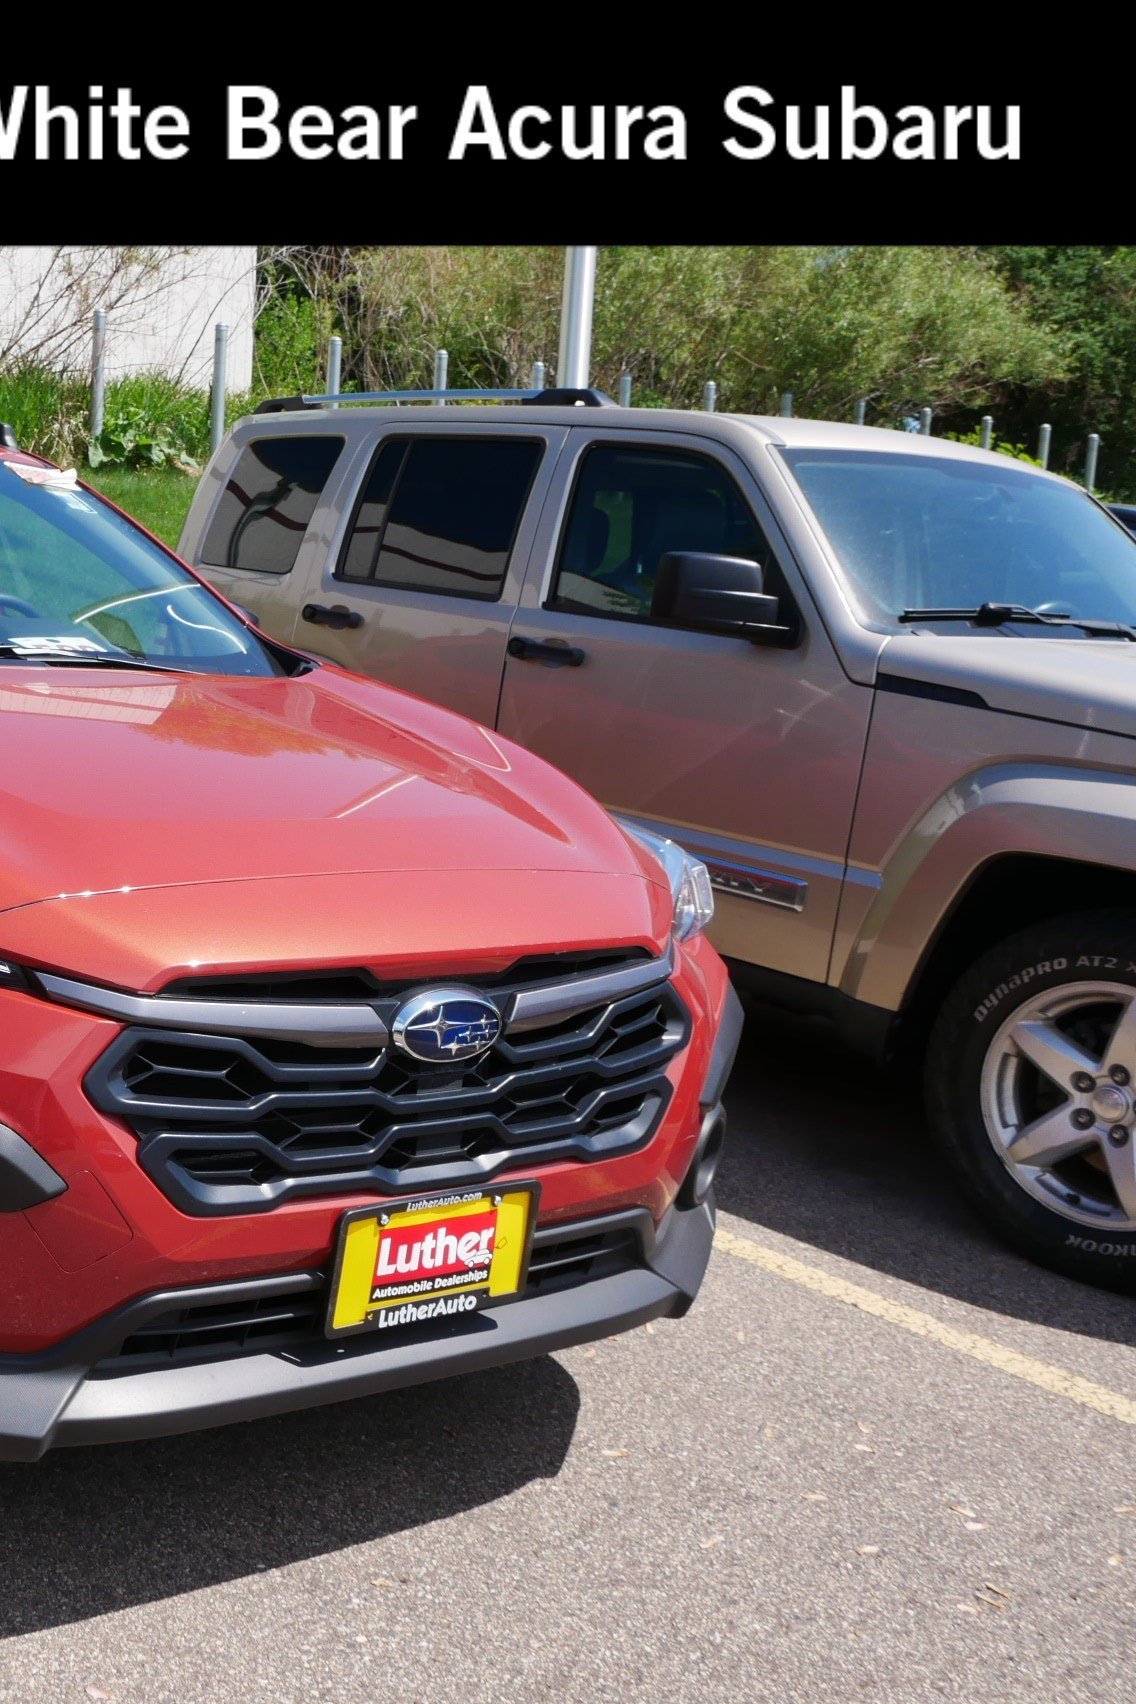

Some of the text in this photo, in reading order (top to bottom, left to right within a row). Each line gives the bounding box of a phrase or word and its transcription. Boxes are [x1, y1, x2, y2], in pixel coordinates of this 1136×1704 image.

[1075, 955, 1118, 969] AT2
[406, 1192, 483, 1212] LutherAuto.com
[376, 1227, 495, 1277] Luther
[372, 1270, 488, 1299] Automobile Dealerships
[378, 1294, 477, 1328] LutherAuto
